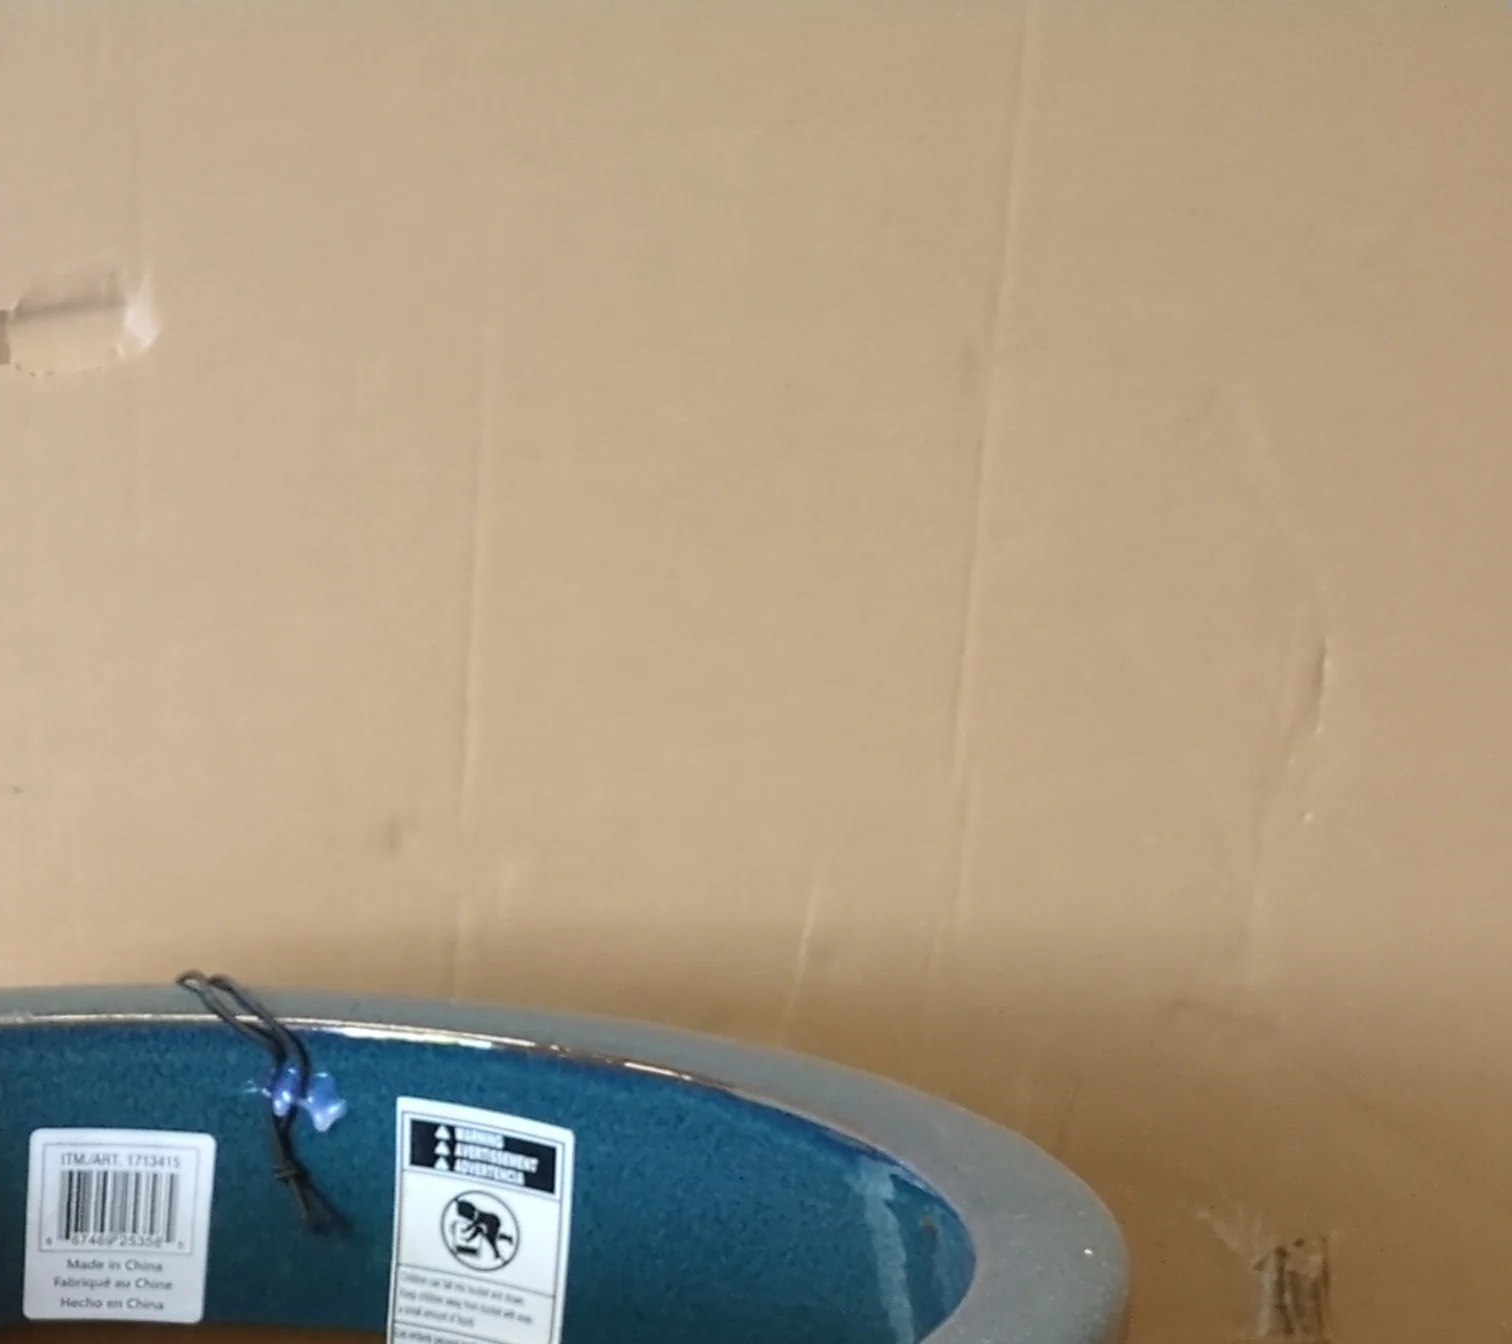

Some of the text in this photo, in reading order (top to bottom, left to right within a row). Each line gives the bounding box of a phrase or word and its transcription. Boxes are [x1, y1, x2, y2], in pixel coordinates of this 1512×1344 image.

[67, 1258, 163, 1272] Made in China
[53, 1276, 110, 1291] Fabriqué
[60, 1297, 164, 1310] Hecho en China
